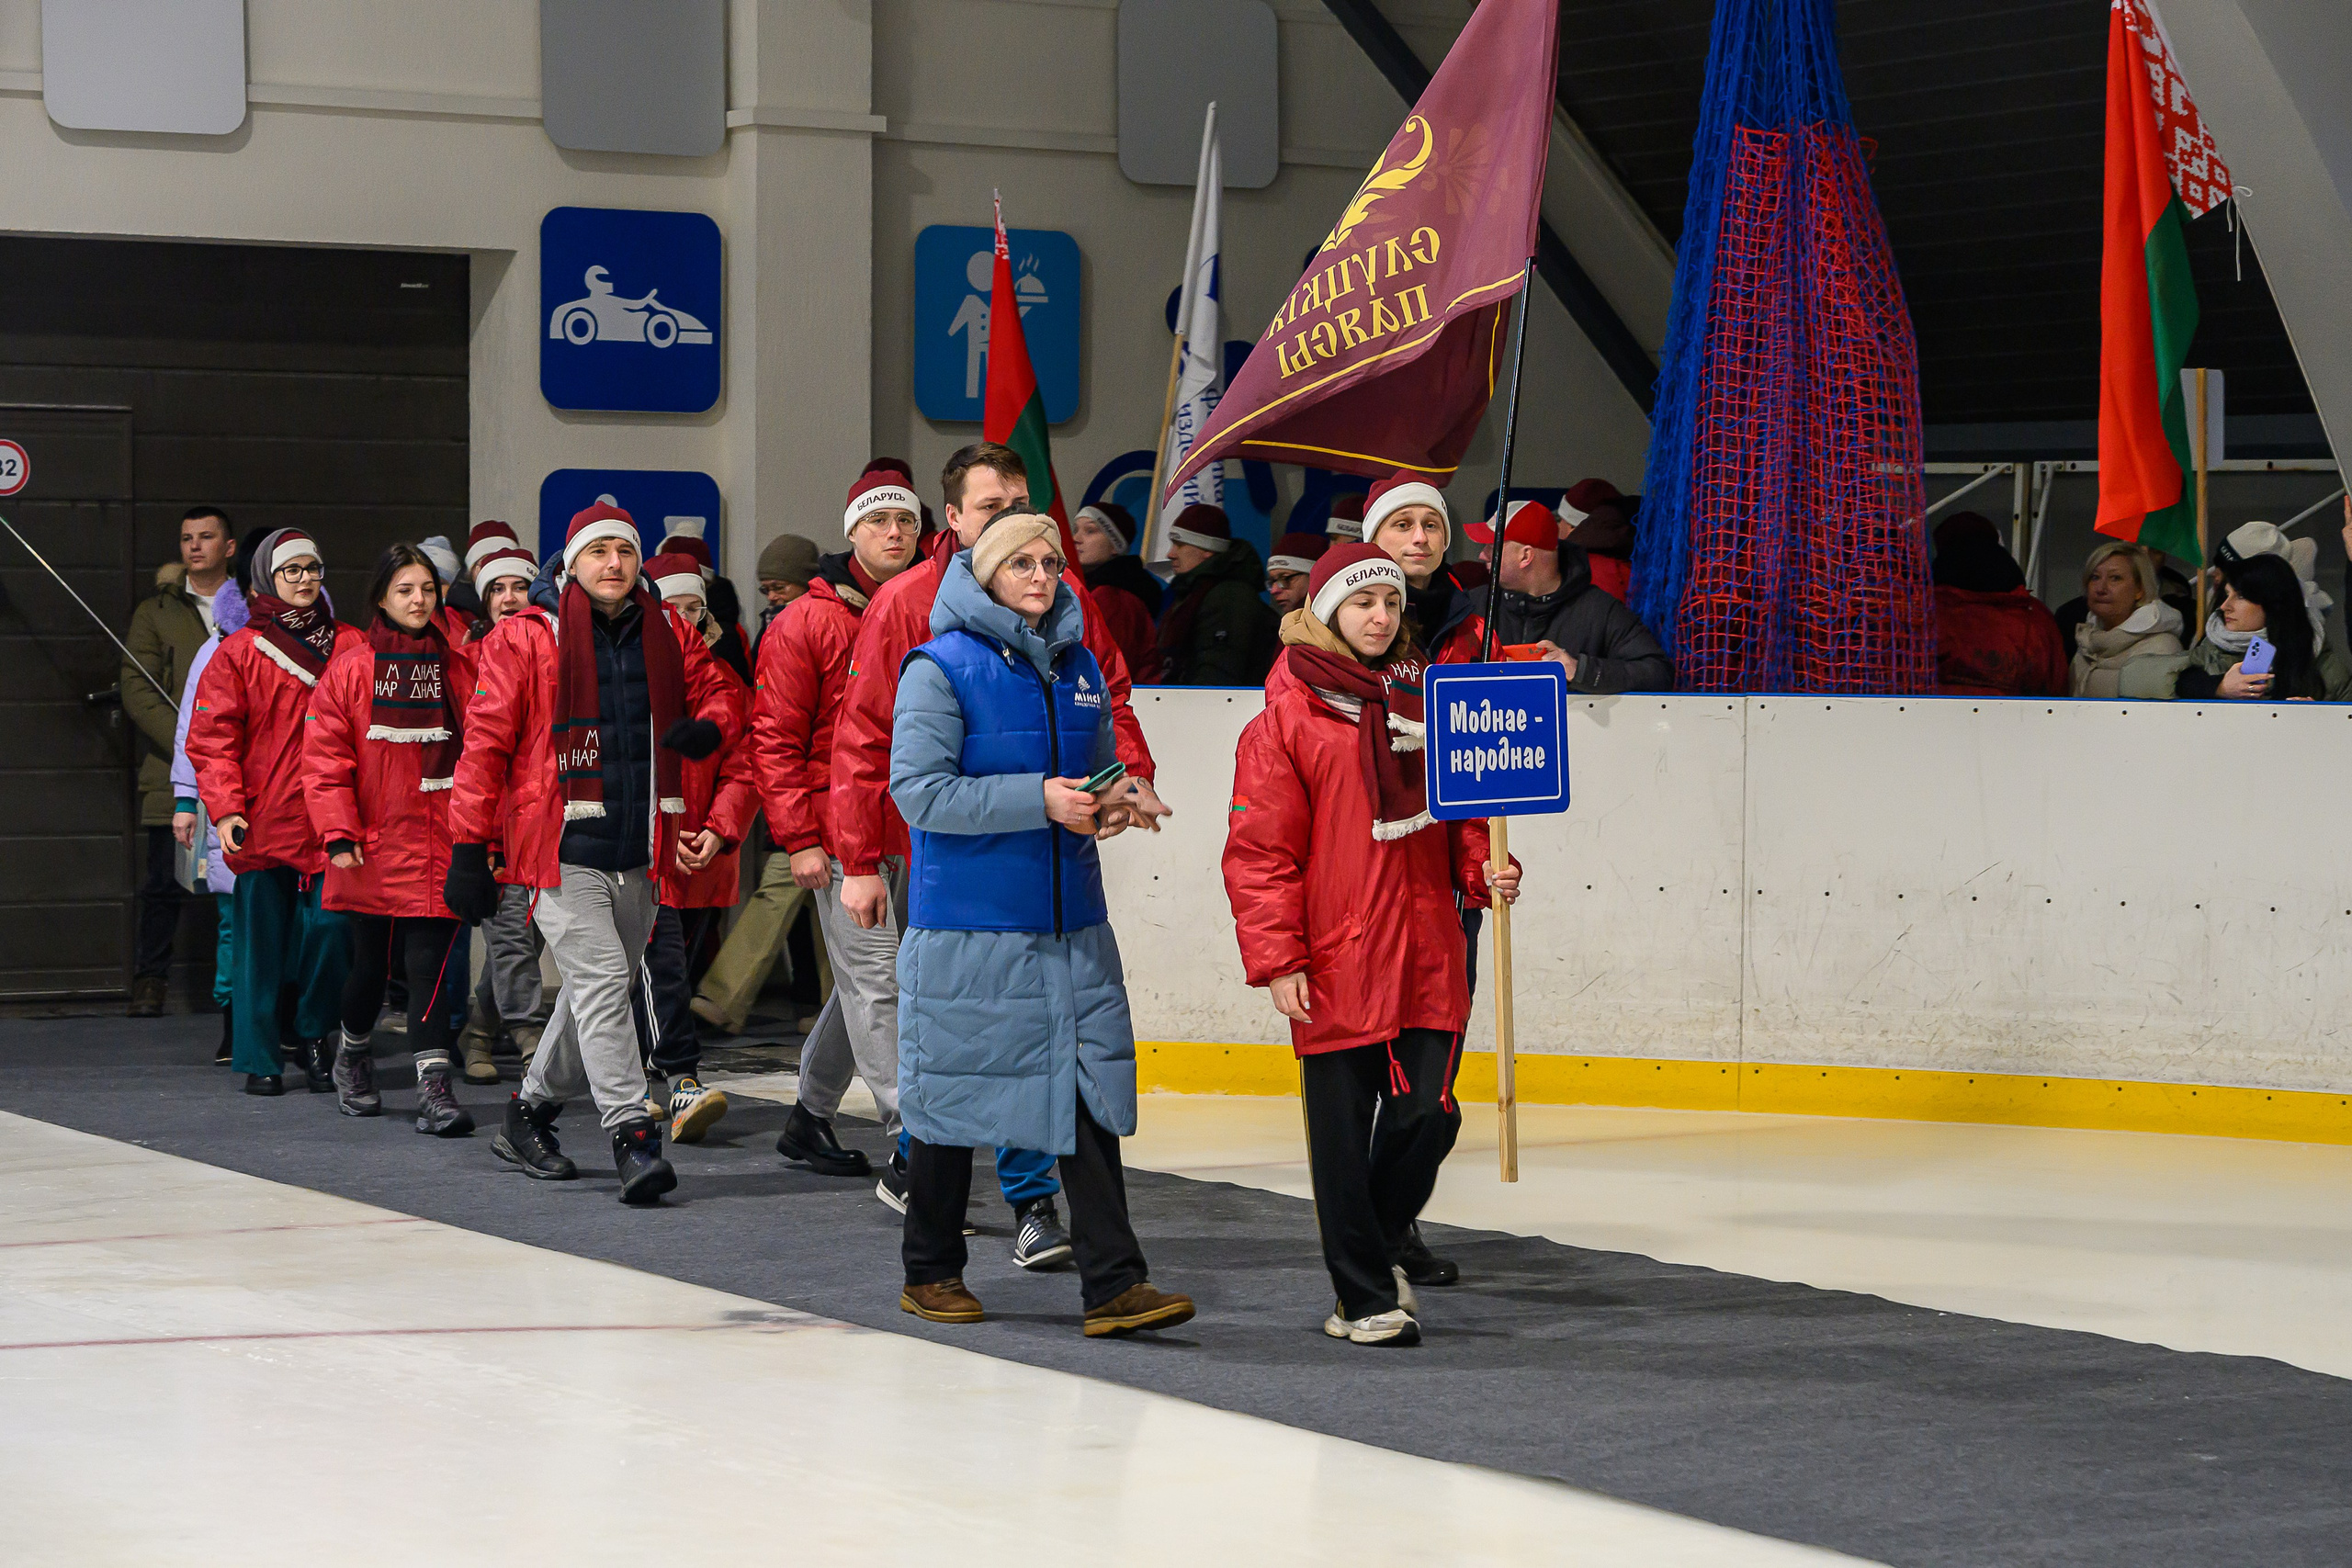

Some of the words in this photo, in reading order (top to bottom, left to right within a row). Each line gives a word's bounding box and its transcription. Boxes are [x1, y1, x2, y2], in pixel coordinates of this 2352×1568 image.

[857, 492, 906, 512] БЕЛАРУСЬ
[1345, 566, 1401, 587] БЕЛАРУСЬ
[1390, 663, 1420, 682] НАР
[1450, 698, 1528, 734] Моднае
[571, 749, 598, 767] НАР
[1450, 736, 1546, 783] народнае
